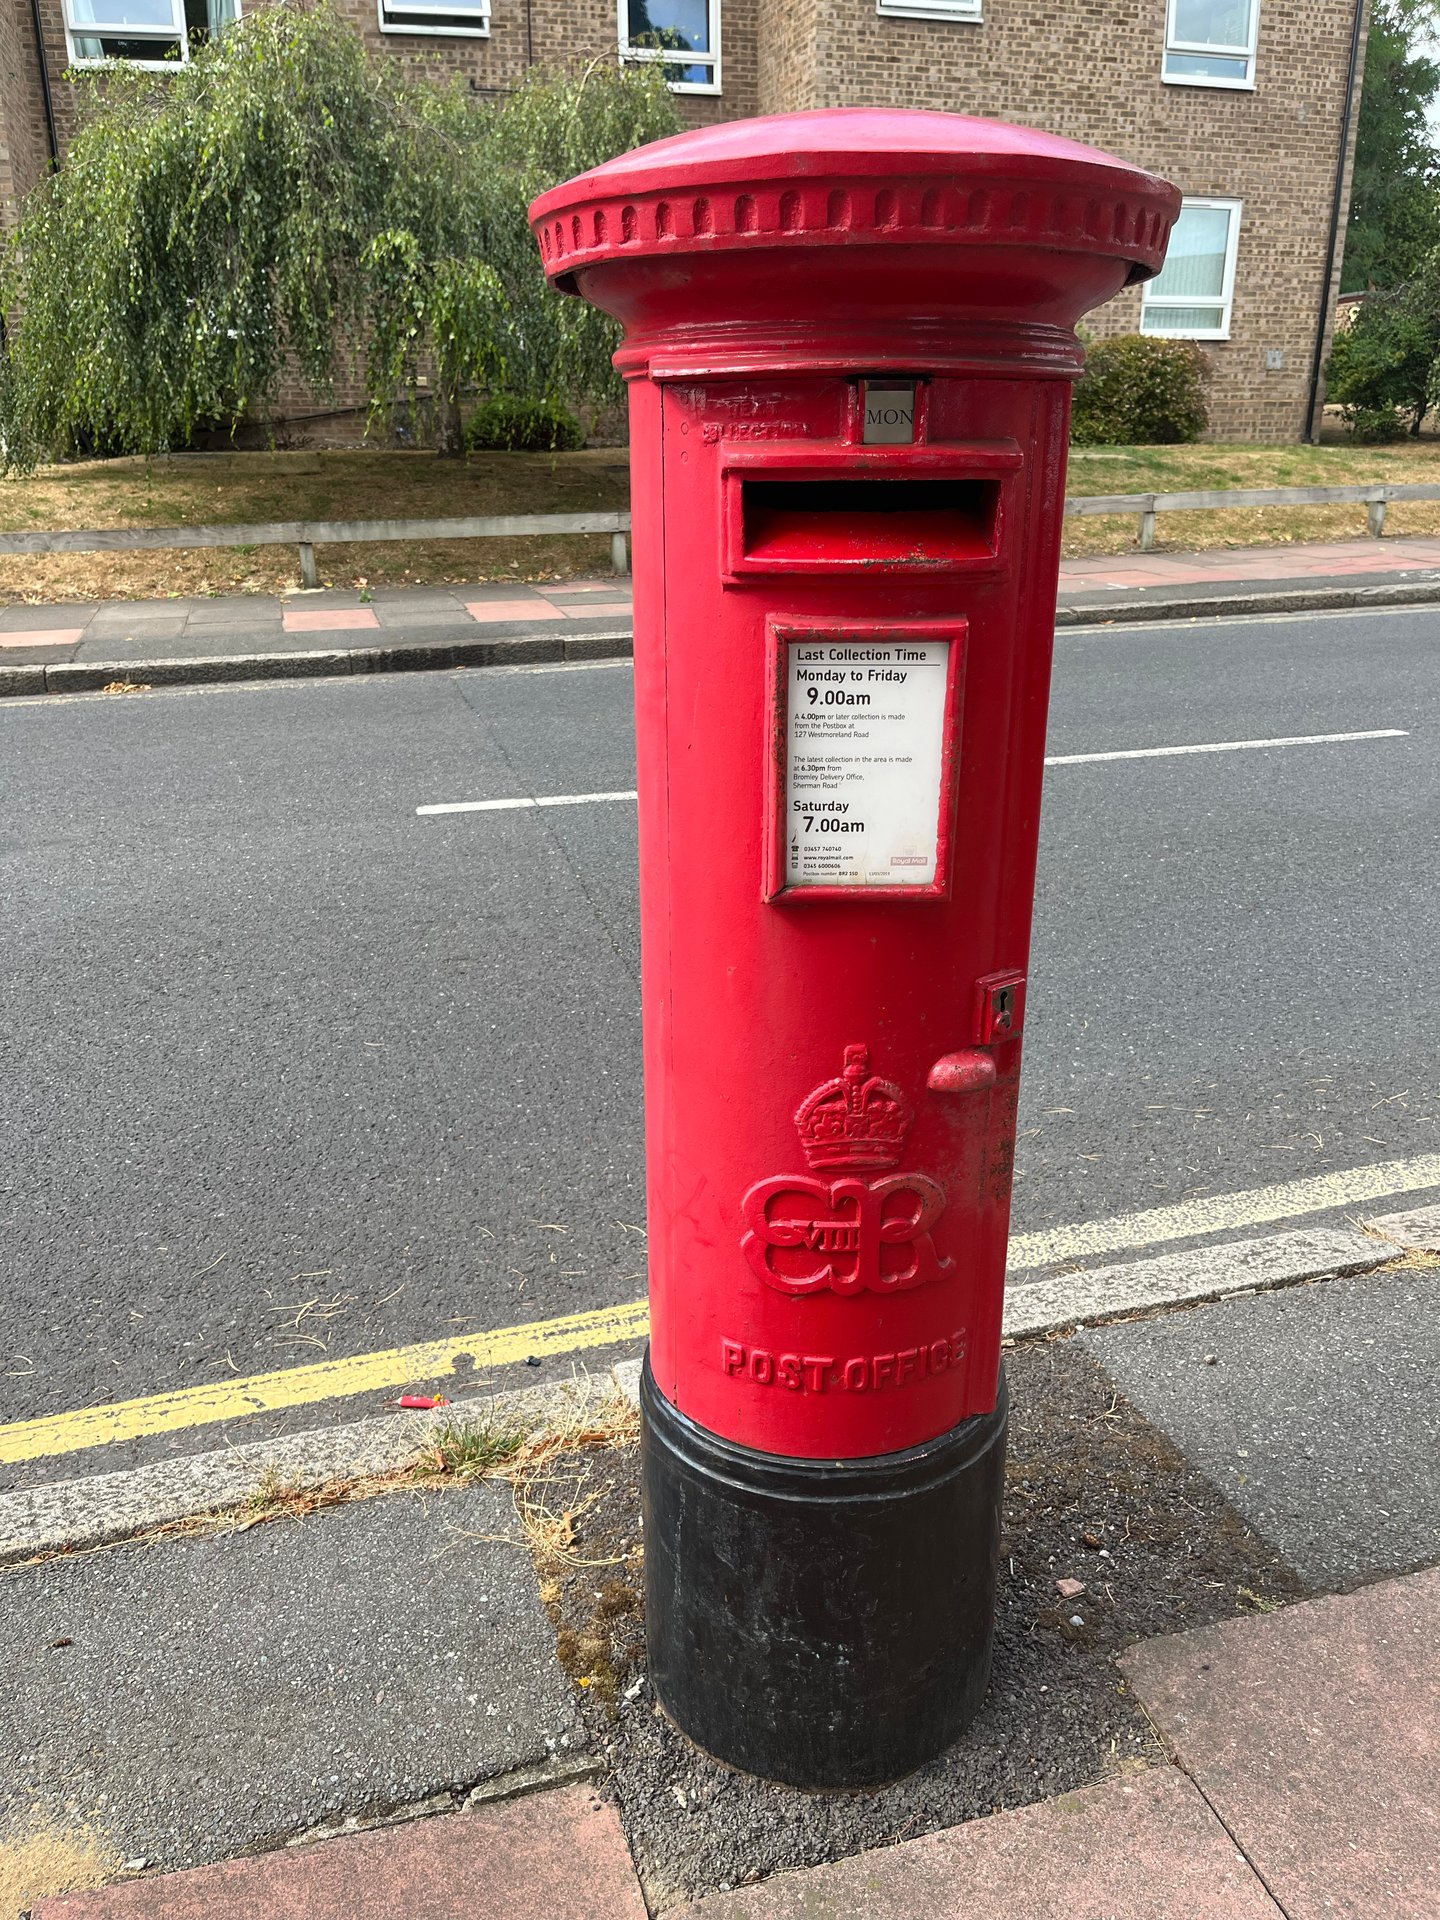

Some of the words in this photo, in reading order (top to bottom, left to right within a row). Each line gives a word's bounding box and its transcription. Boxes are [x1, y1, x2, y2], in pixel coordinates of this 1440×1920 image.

[866, 409, 913, 425] MON
[797, 649, 825, 661] Last
[829, 649, 891, 661] Collection
[894, 649, 927, 661] Time
[796, 669, 847, 683] Monday
[850, 670, 863, 681] to
[868, 669, 908, 683] Friday
[806, 687, 871, 706] 9.00am
[801, 713, 826, 722] 4.00pm
[801, 764, 826, 773] 6.30pm
[793, 774, 819, 782] Bromley
[820, 774, 845, 782] Delivery
[793, 800, 850, 814] Saturday
[802, 815, 865, 833] 7.00am
[721, 1335, 836, 1393] POST
[842, 1326, 968, 1393] OFFICE
